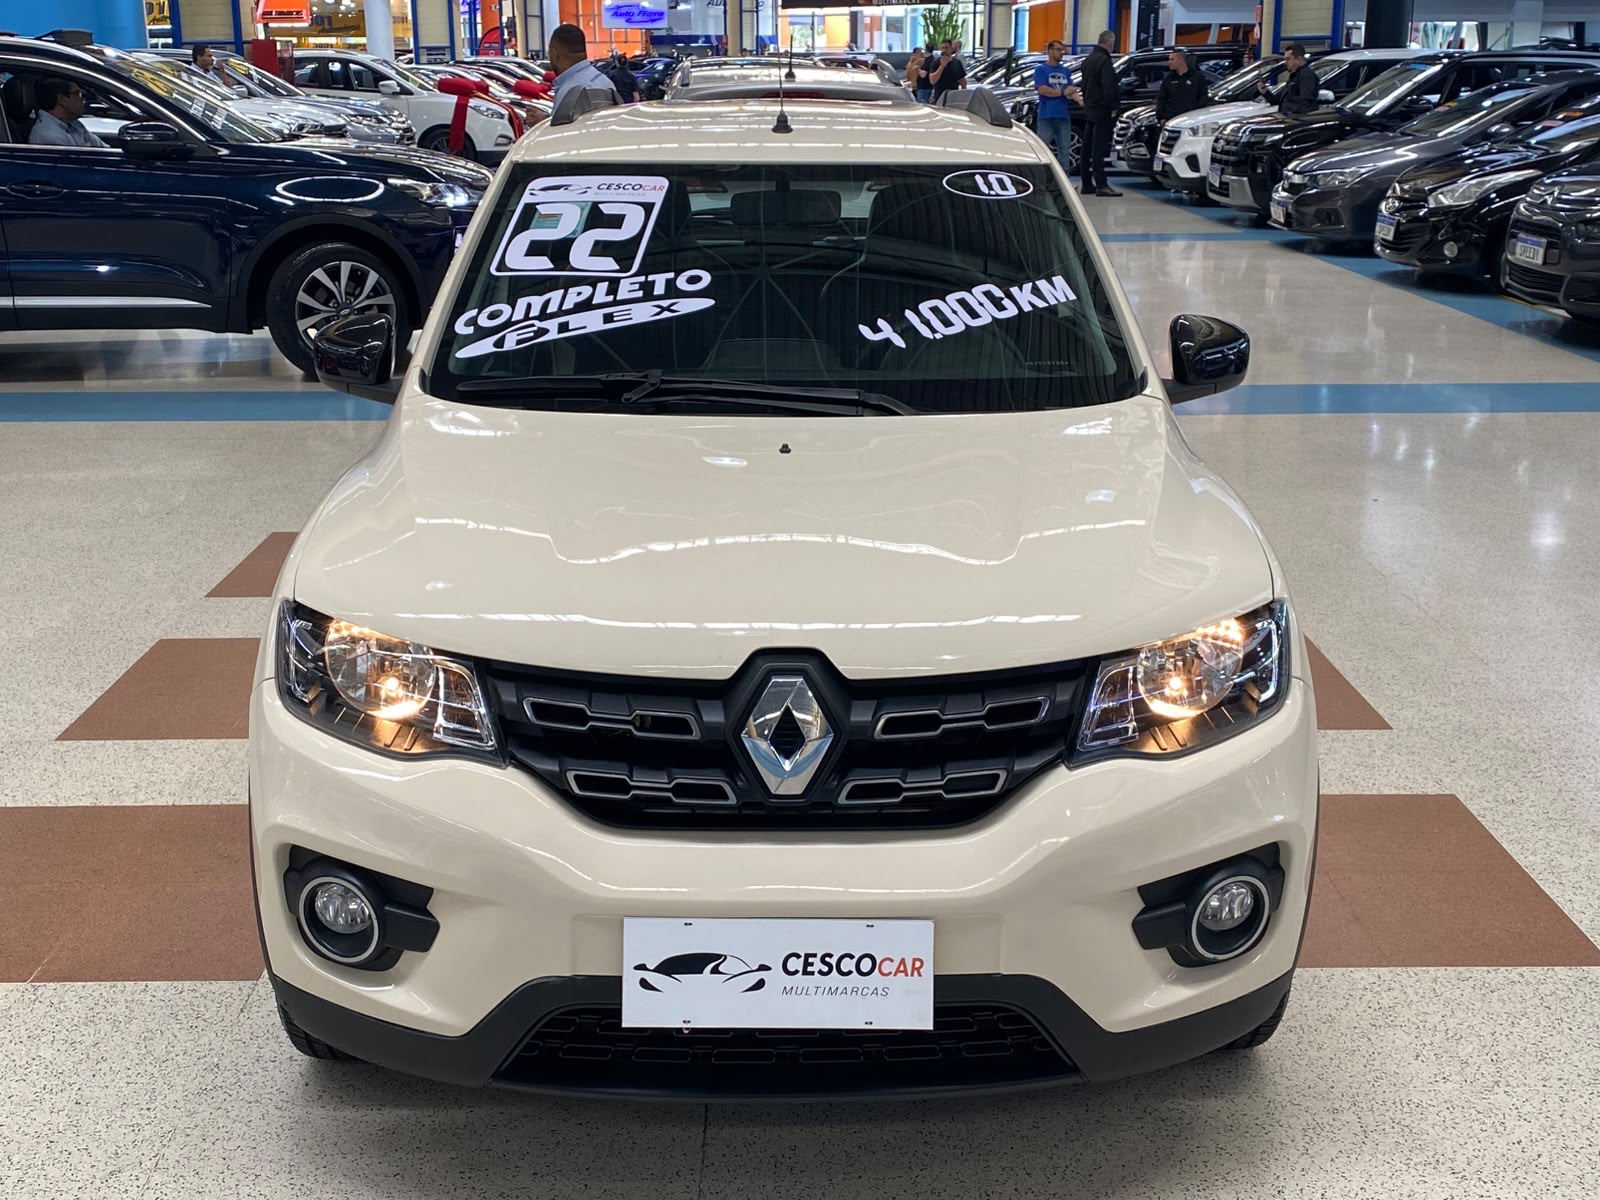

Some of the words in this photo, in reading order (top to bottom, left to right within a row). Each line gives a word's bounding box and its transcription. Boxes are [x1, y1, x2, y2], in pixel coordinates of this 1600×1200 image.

[637, 9, 665, 17] Fluxo
[974, 173, 1017, 196] 1.0
[504, 203, 646, 271] 22
[453, 269, 713, 335] COMPLETO
[503, 301, 682, 349] FLEX
[781, 952, 925, 977] CESCOCAR
[781, 986, 890, 996] MULTIMARCAS
